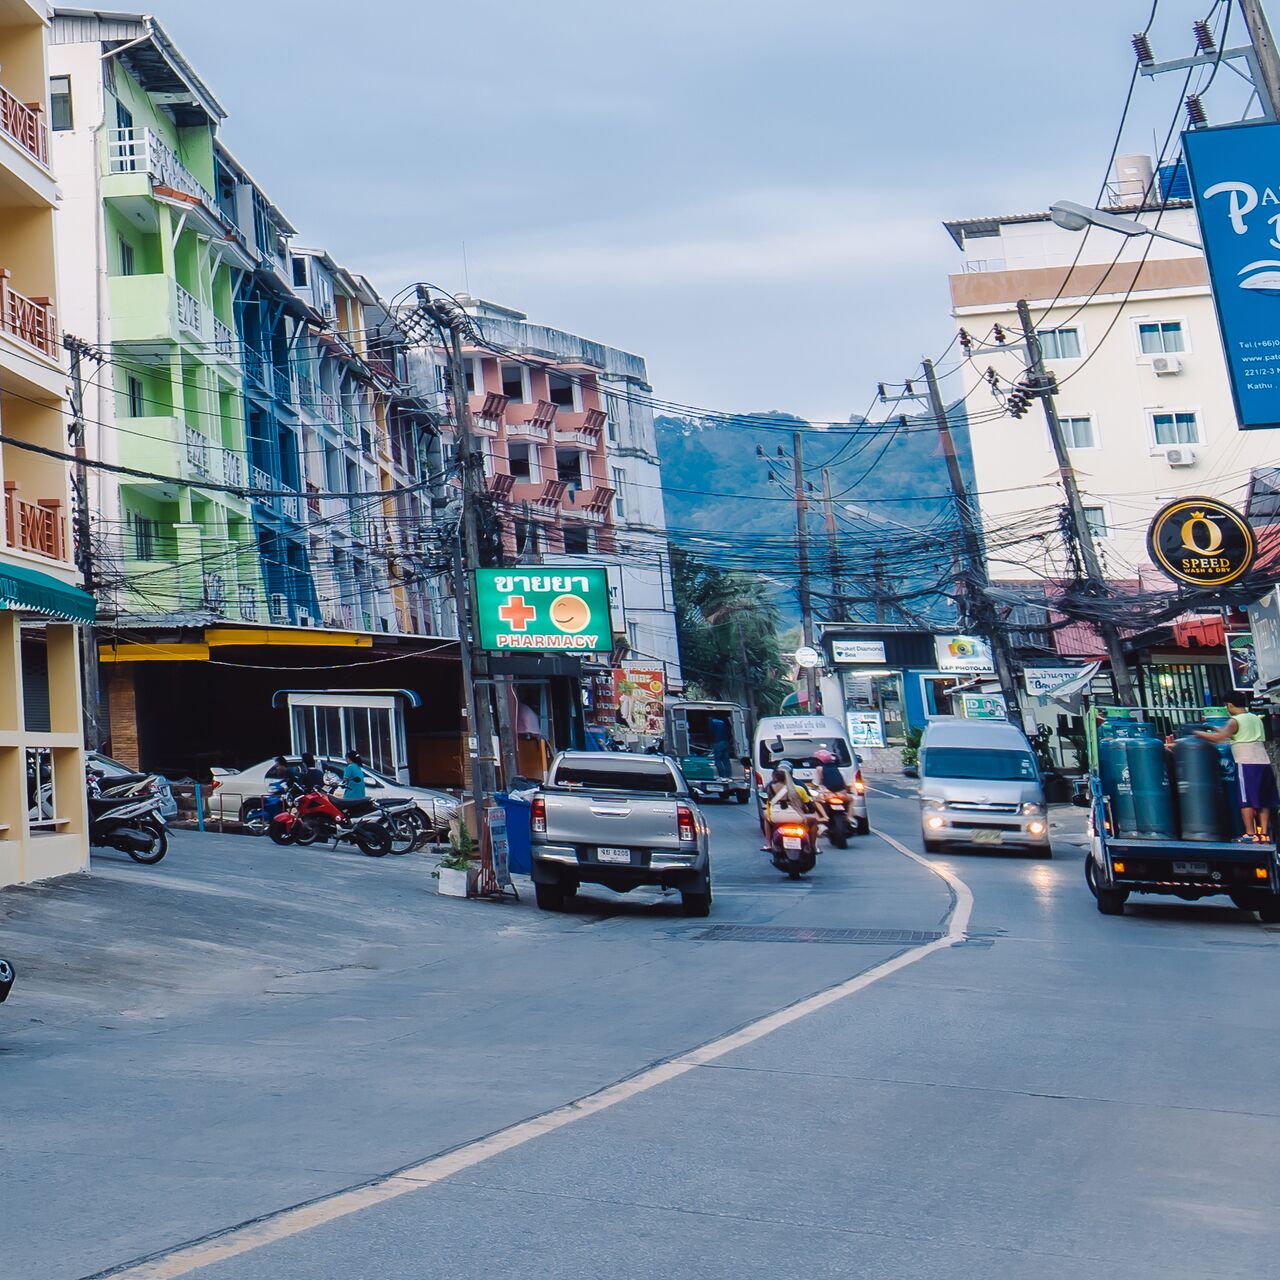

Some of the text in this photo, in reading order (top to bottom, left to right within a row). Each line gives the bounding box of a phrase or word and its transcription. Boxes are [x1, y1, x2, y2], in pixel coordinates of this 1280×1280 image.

[1203, 181, 1280, 234] PA
[1181, 518, 1225, 556] Q
[1182, 558, 1230, 568] SPEED
[494, 576, 590, 593] ขายยา
[497, 634, 598, 648] PHARMACY
